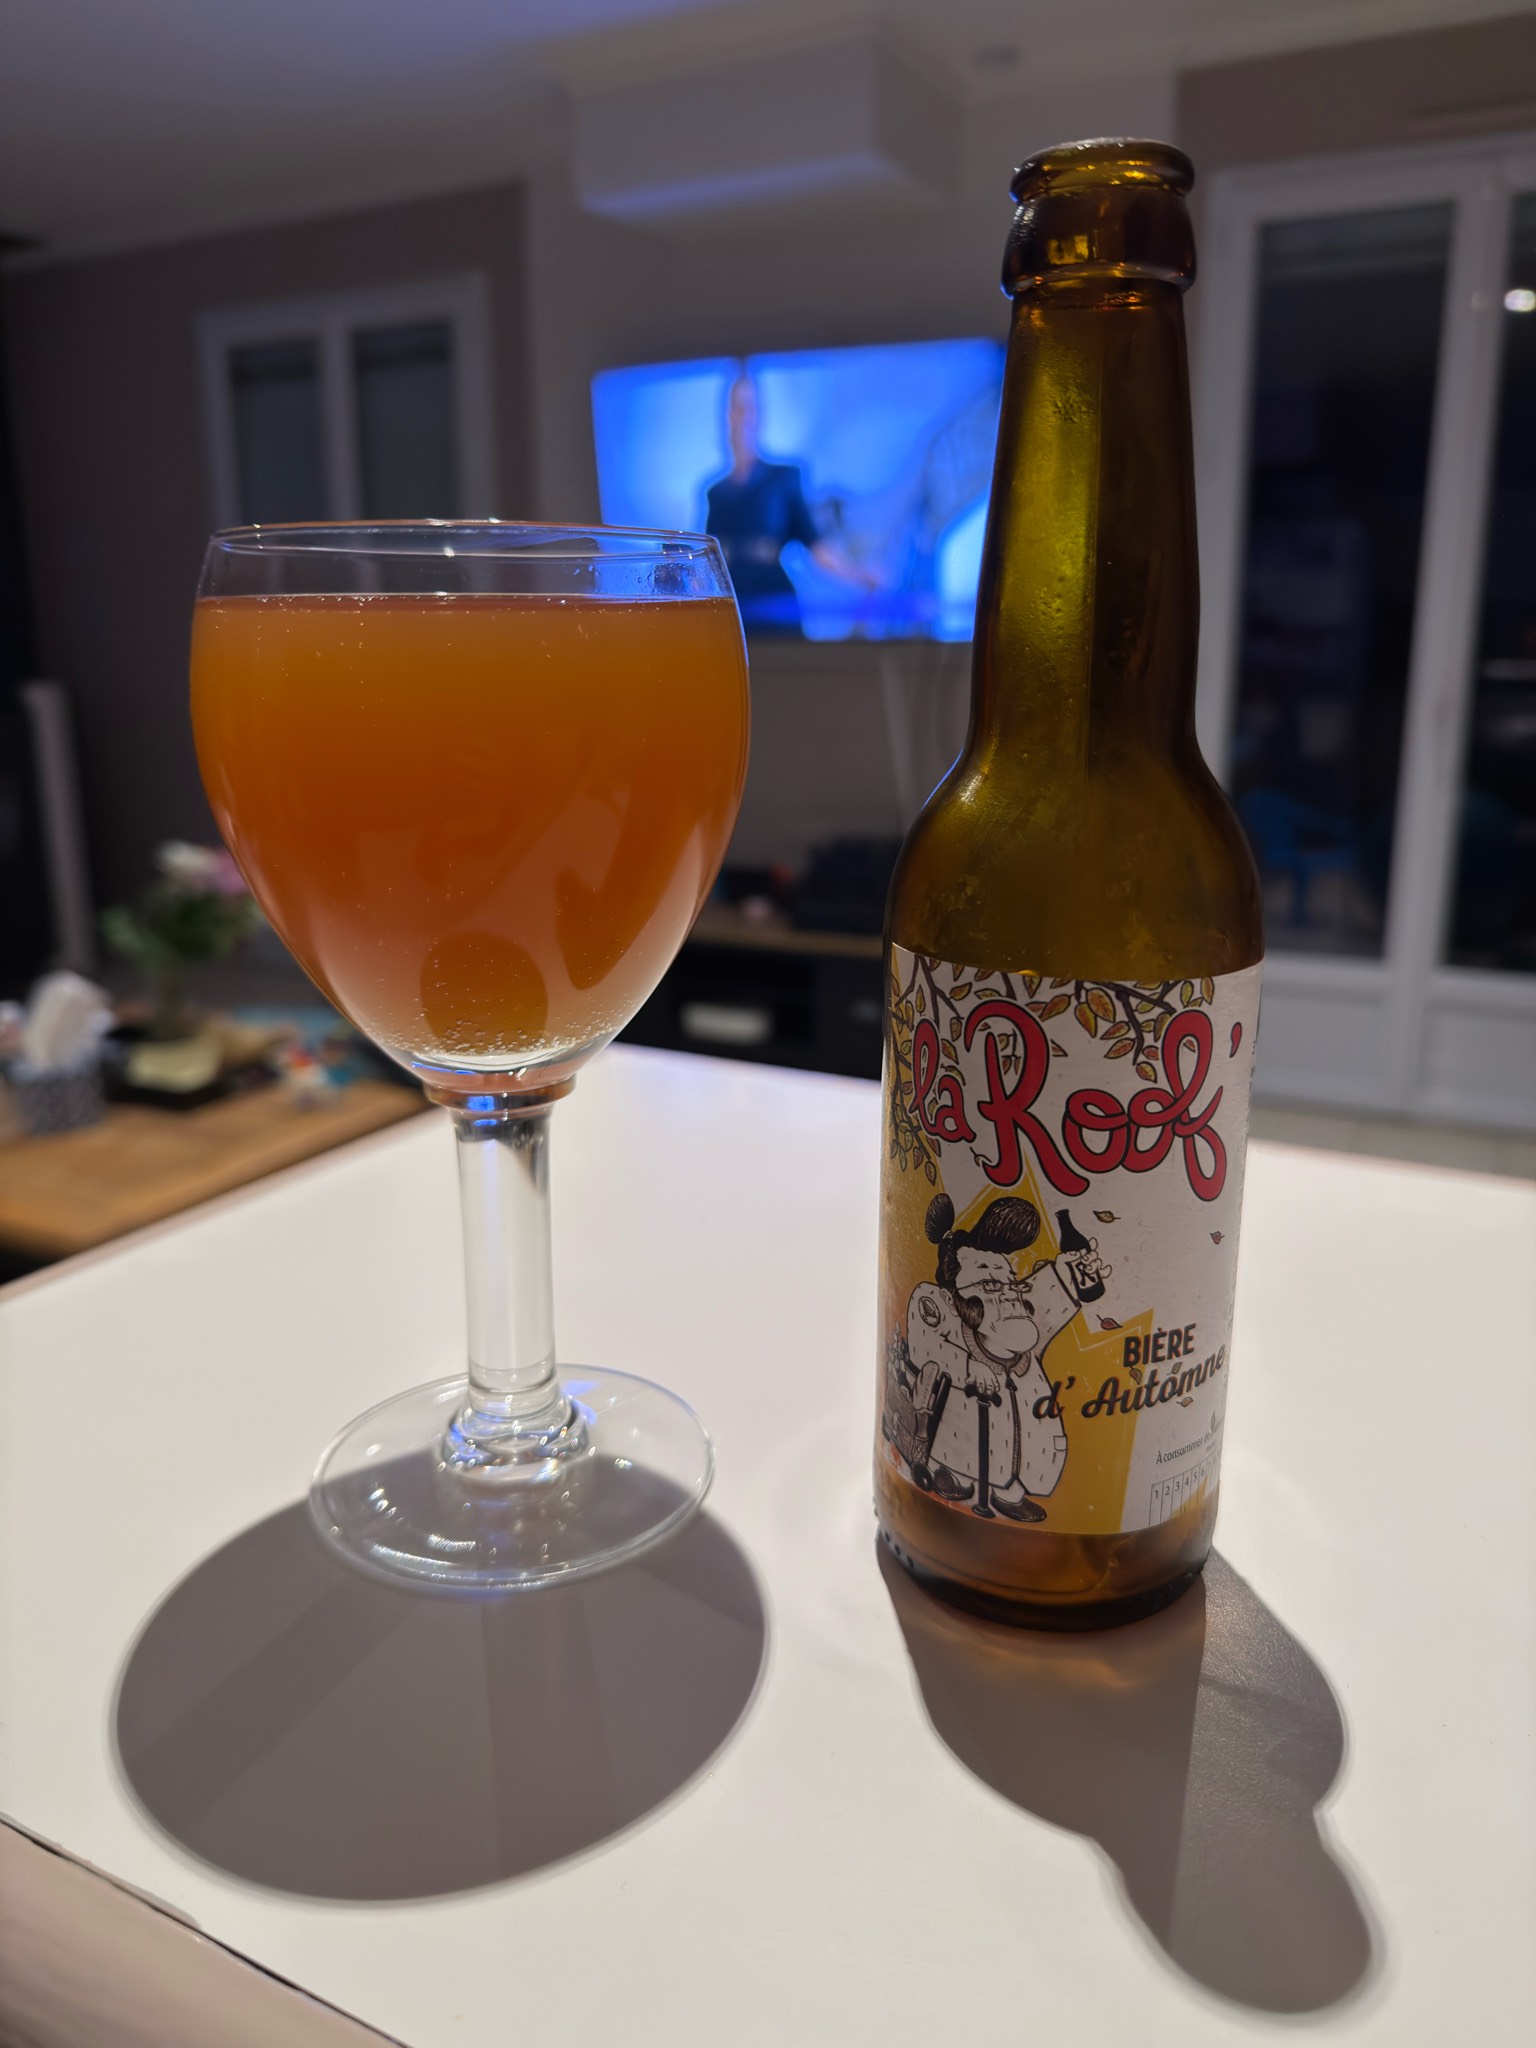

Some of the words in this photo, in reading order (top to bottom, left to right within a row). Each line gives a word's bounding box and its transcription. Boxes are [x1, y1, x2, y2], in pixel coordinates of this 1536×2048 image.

[1123, 1323, 1197, 1368] BIÈRE
[1081, 1346, 1225, 1417] Automne
[1163, 1438, 1204, 1462] consommer
[1165, 1485, 1170, 1496] 2
[1174, 1481, 1180, 1492] 3
